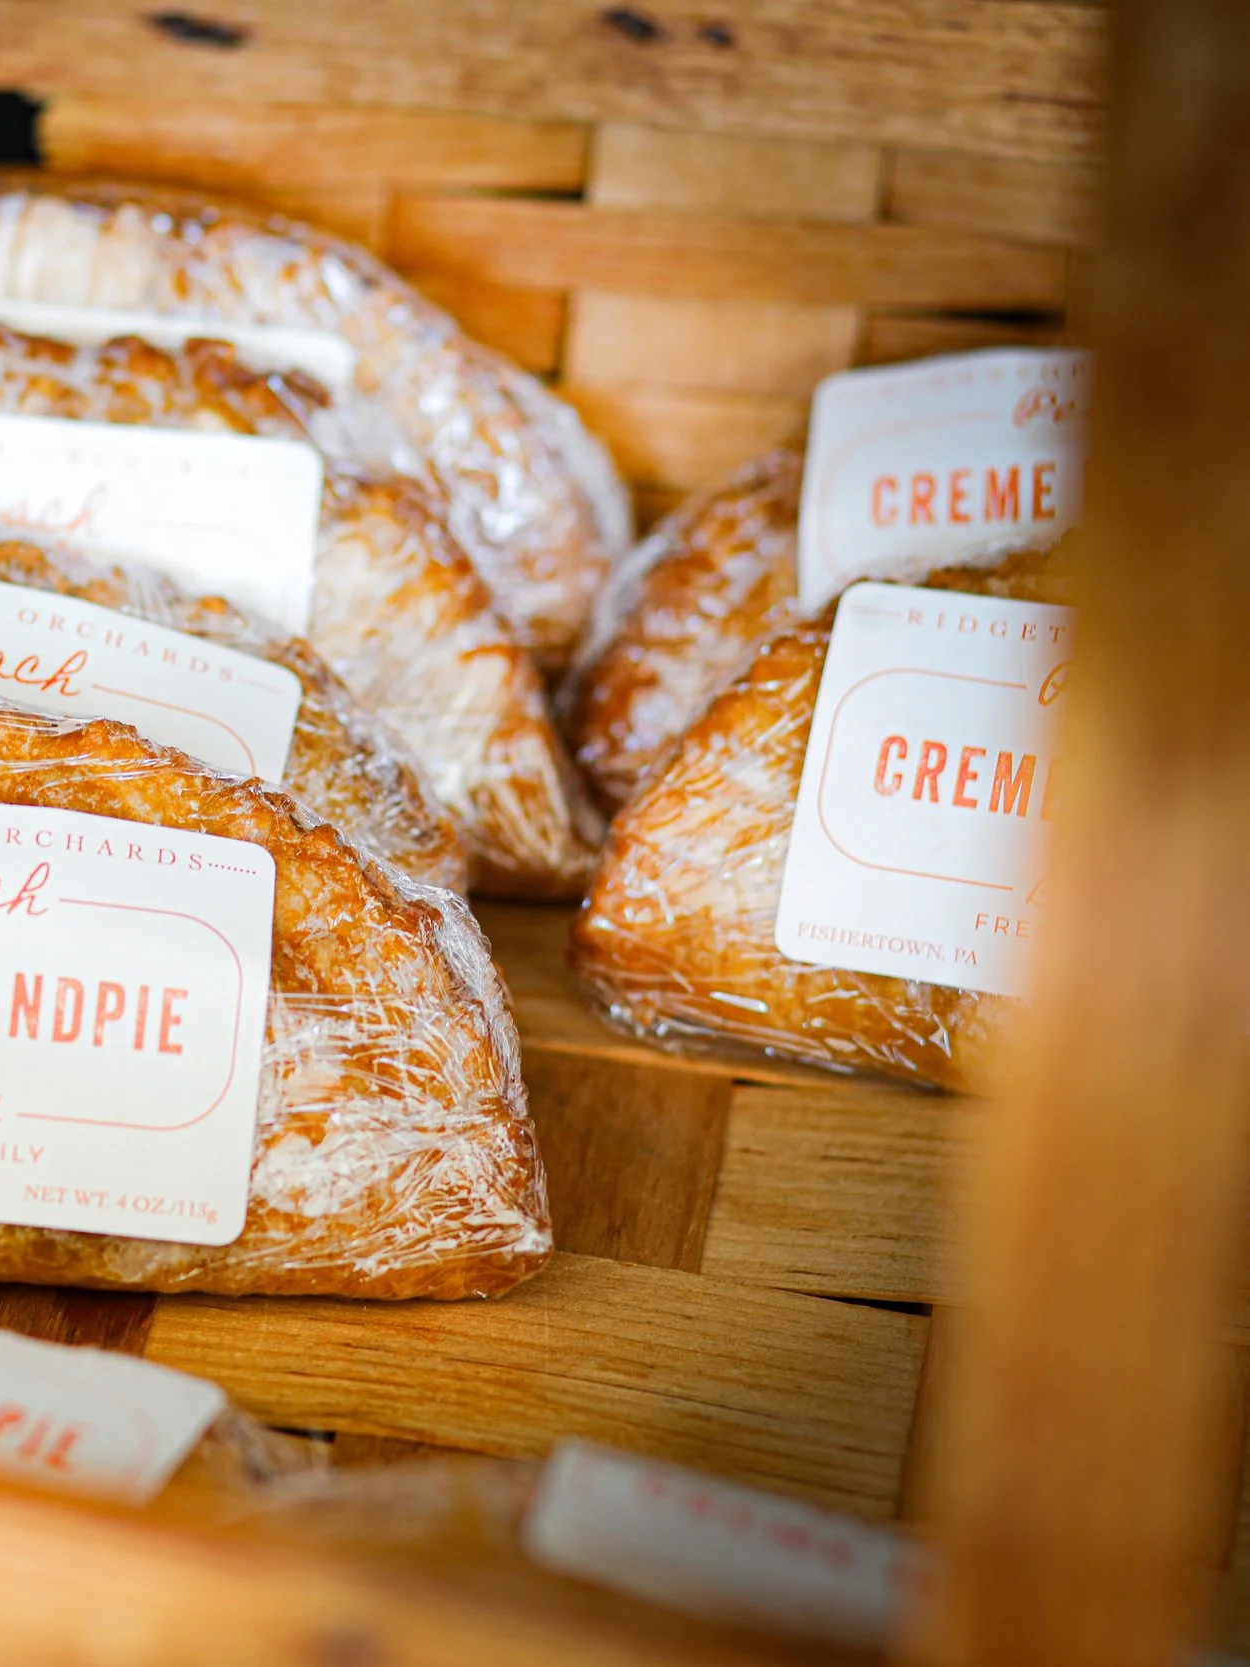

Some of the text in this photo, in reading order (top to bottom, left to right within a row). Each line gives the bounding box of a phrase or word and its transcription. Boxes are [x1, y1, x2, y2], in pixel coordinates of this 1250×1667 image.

[871, 461, 1056, 528] CREME
[908, 607, 1068, 644] RIDGET
[18, 606, 235, 682] ORCHARDS
[974, 911, 1032, 939] FRE
[953, 947, 979, 965] PA
[24, 1184, 69, 1205] NET
[116, 1194, 128, 1210] 4
